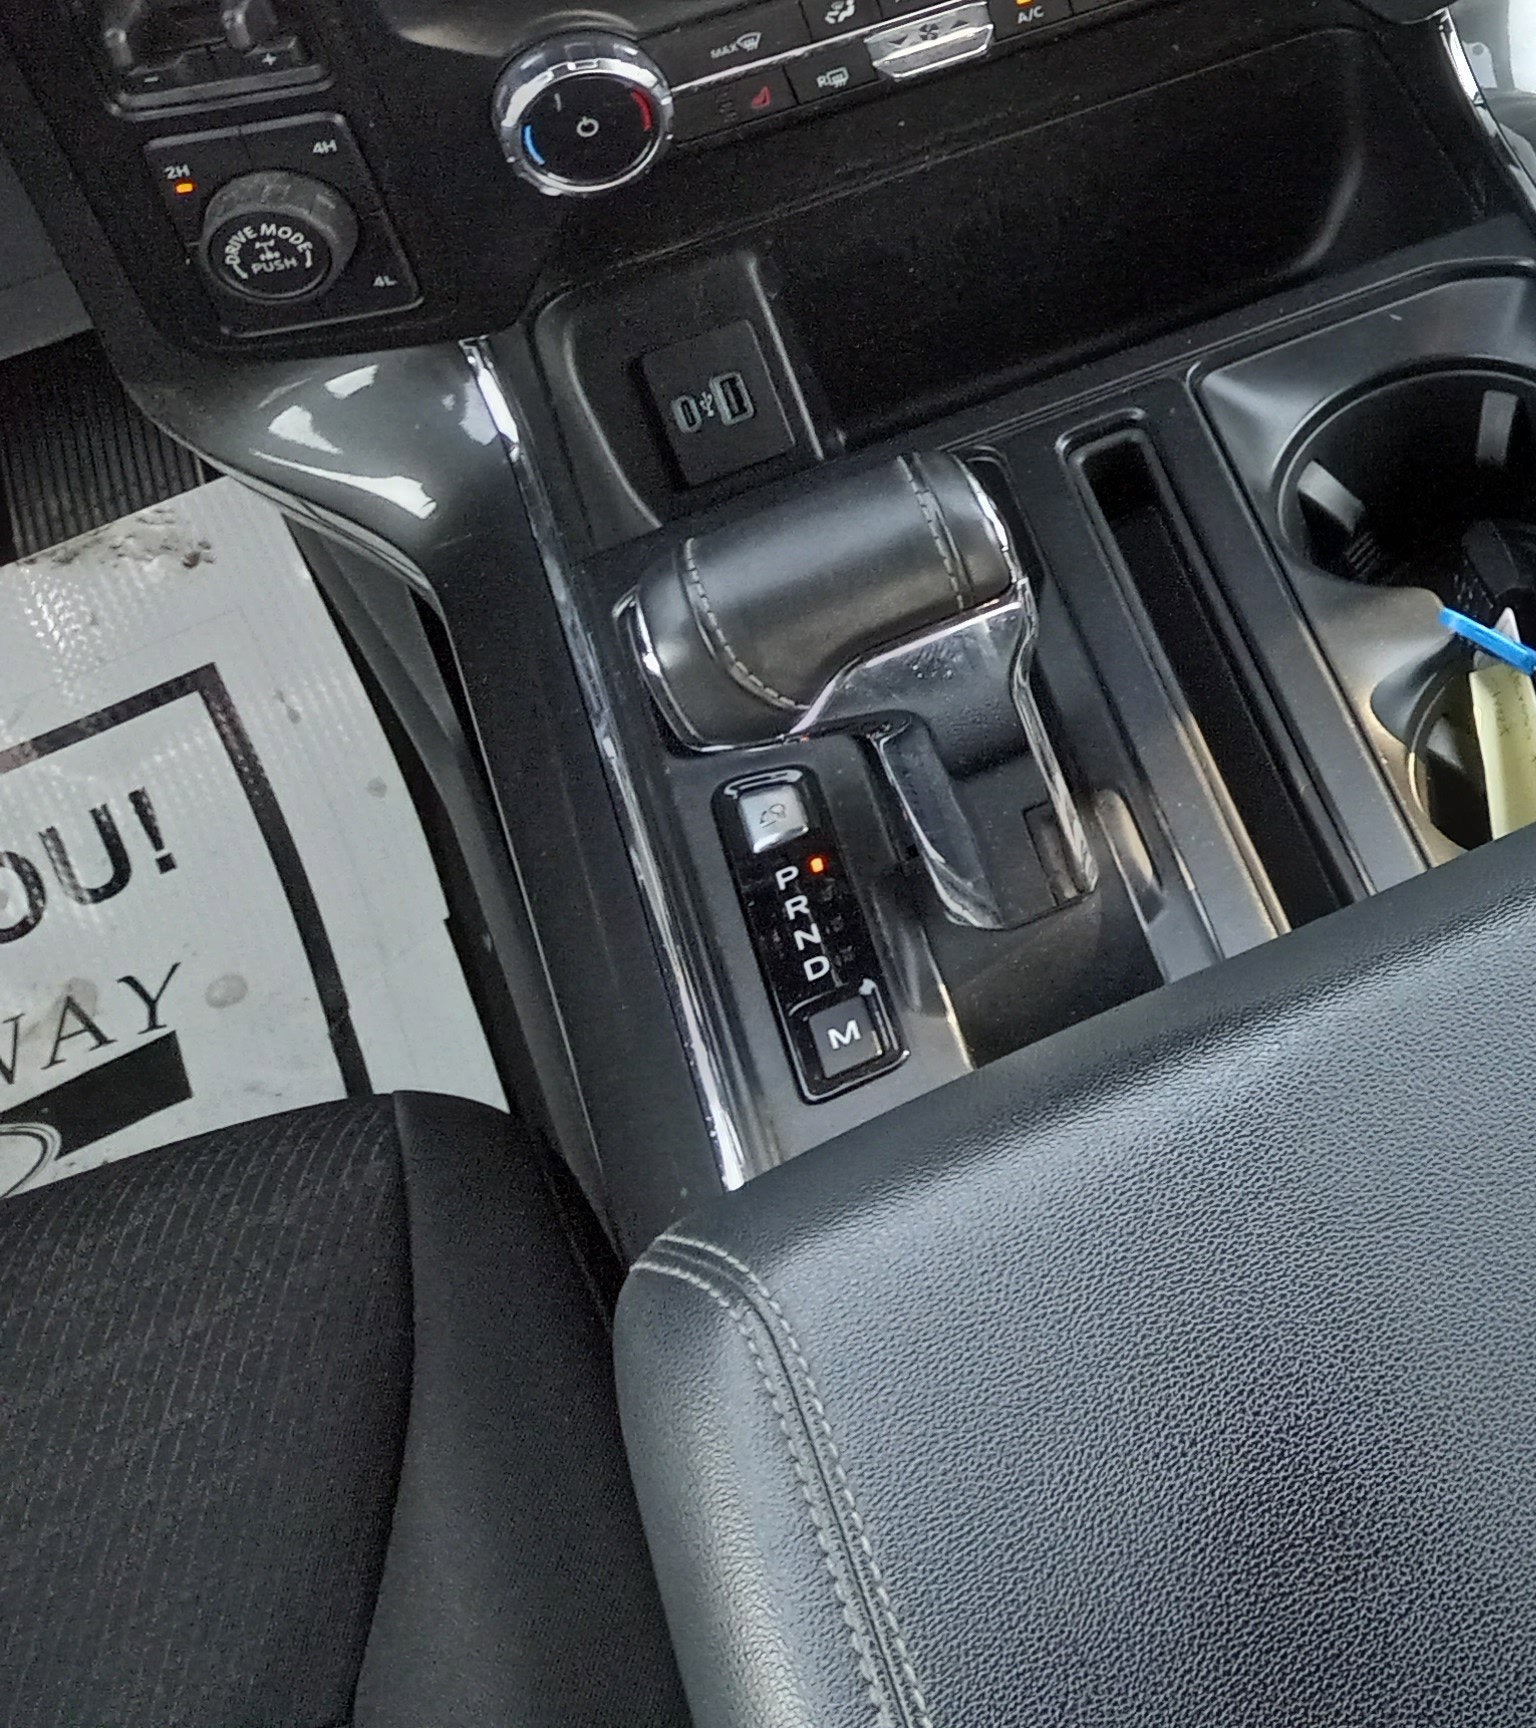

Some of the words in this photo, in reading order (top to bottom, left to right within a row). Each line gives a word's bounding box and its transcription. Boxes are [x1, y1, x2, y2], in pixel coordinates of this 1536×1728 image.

[1016, 5, 1045, 25] A/C
[312, 138, 338, 156] 4H
[163, 162, 191, 181] 2H
[225, 225, 258, 267] DRIVE
[259, 222, 315, 254] MODE
[250, 256, 299, 275] PUSH
[372, 274, 397, 288] 4L
[775, 864, 800, 891] P
[784, 894, 811, 920] R
[793, 922, 824, 951] N
[802, 954, 831, 983] D
[827, 1018, 862, 1050] M
